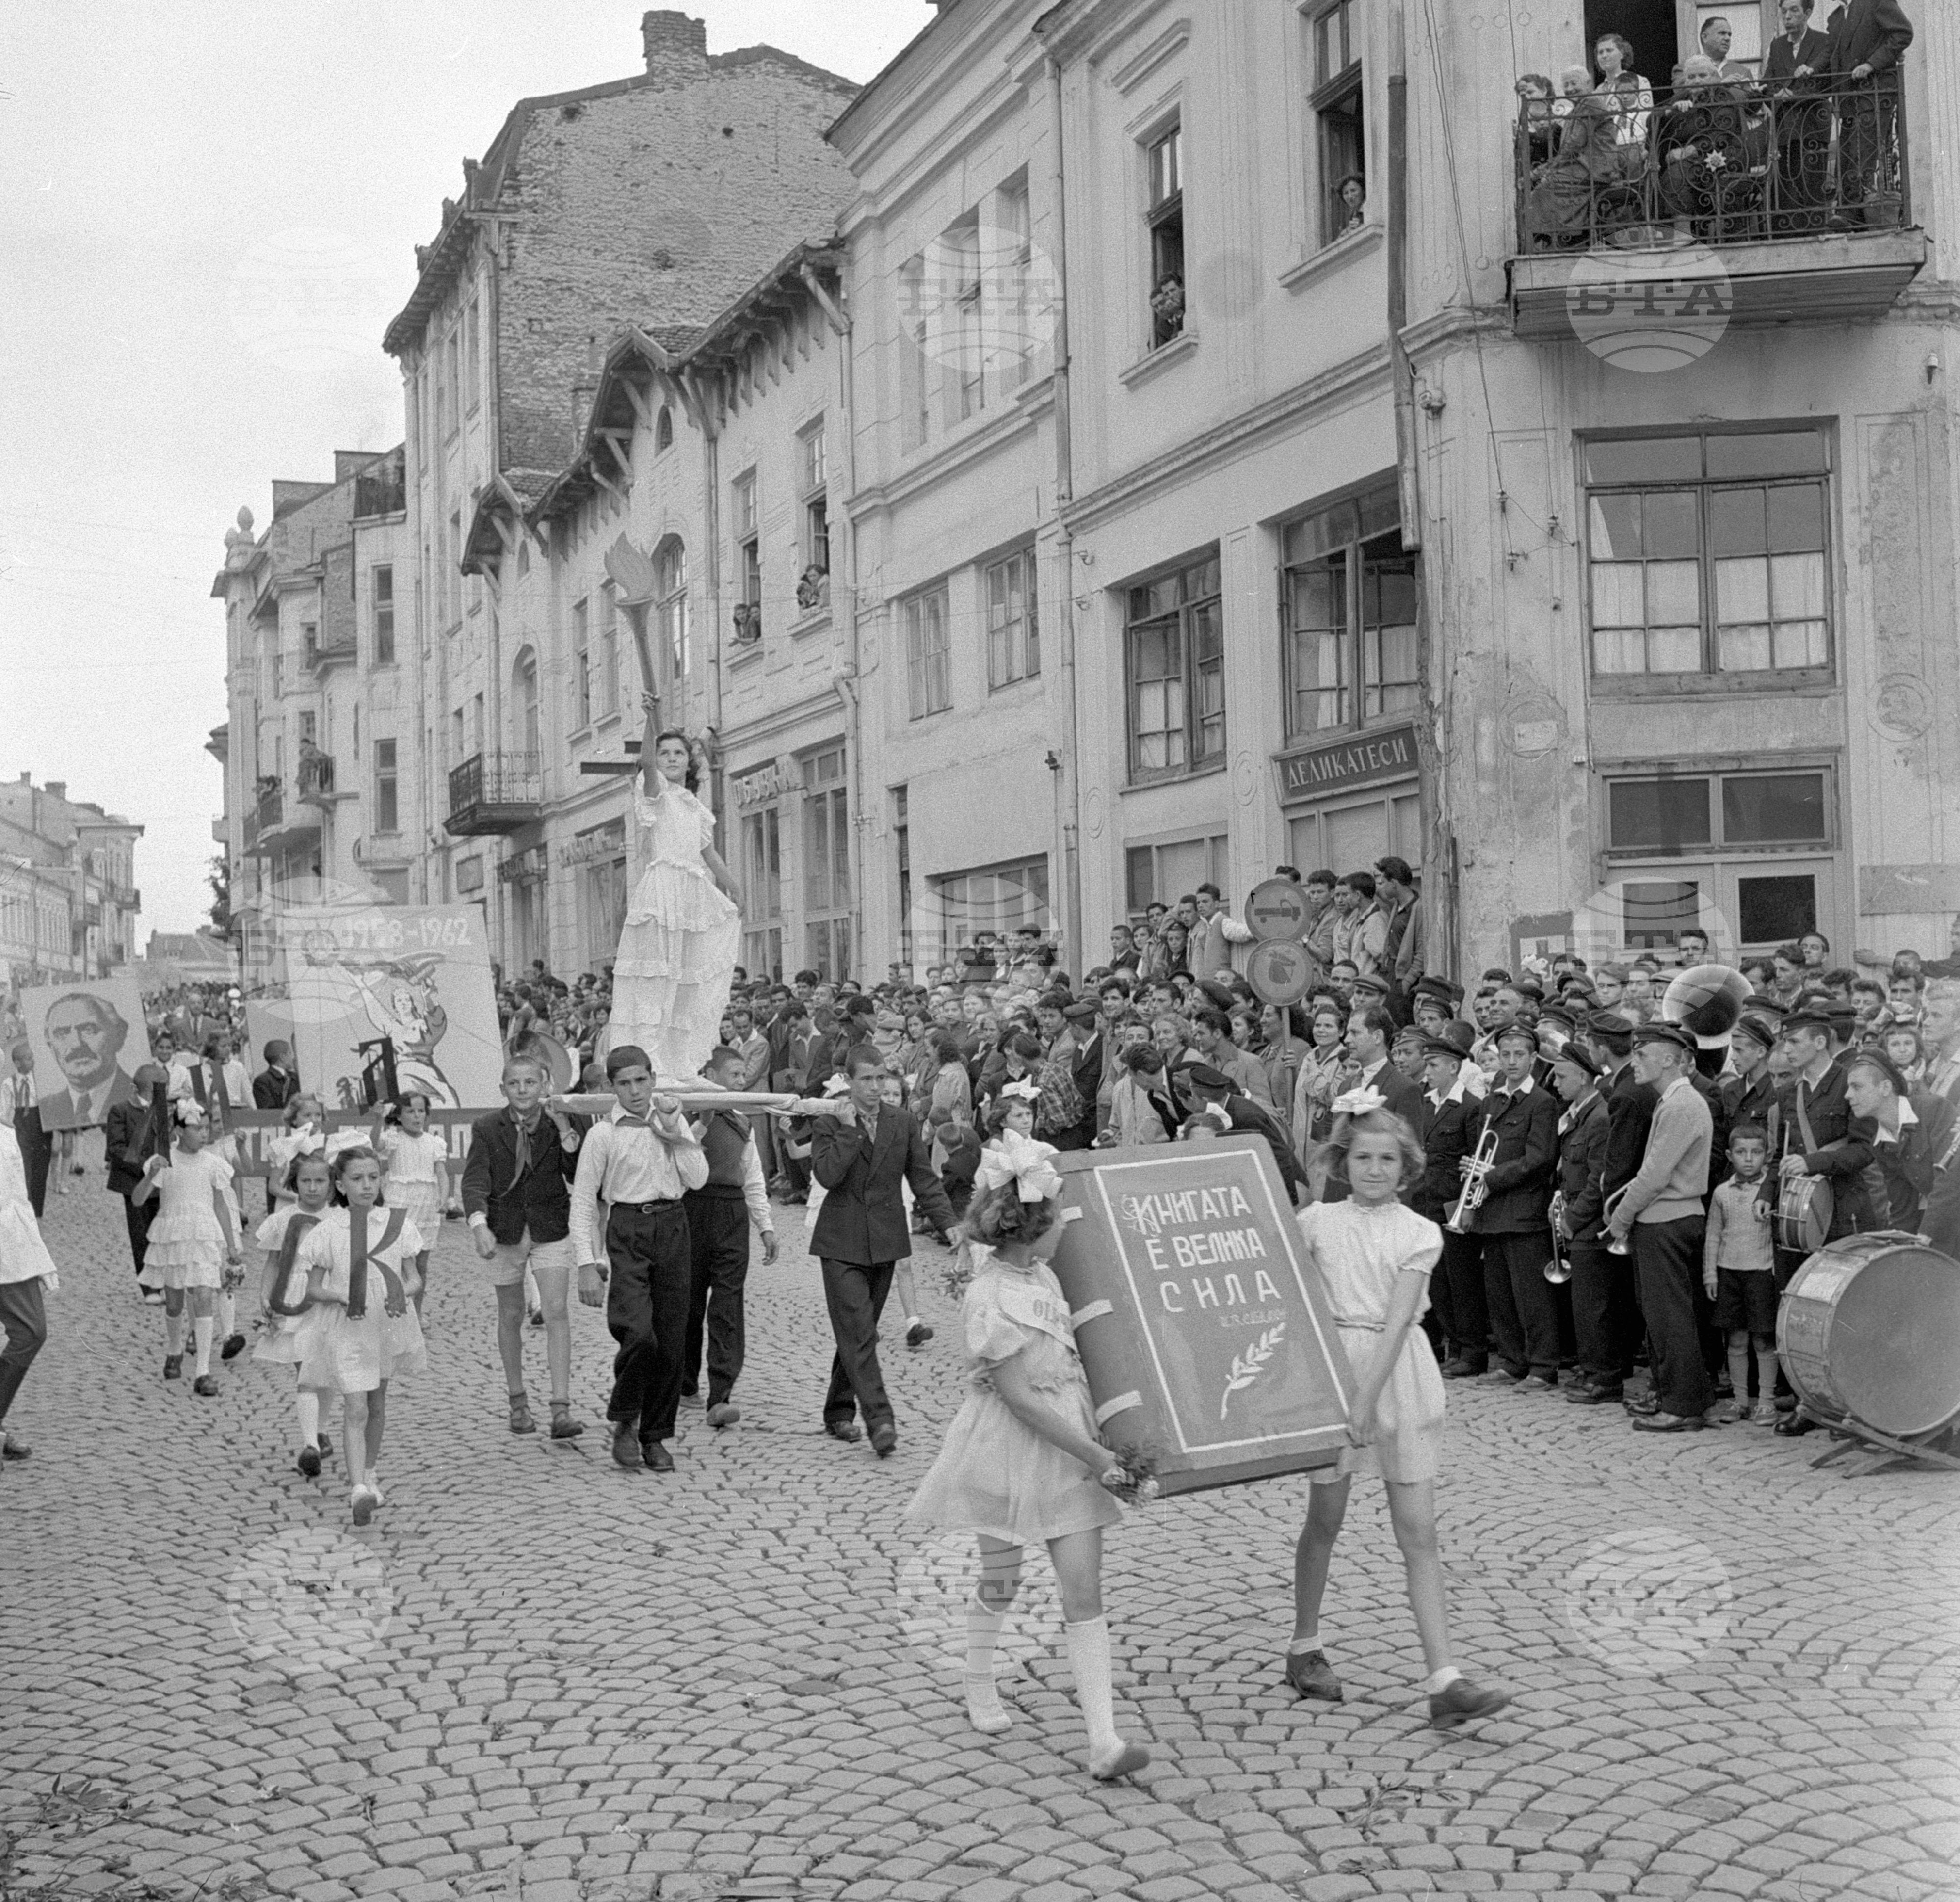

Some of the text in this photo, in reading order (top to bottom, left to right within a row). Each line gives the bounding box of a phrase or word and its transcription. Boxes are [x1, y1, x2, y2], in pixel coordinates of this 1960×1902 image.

[1288, 737, 1409, 790] ДЕЛИКАТЕСИ
[1123, 1186, 1252, 1235] КНИГАТА
[1145, 1227, 1268, 1270] Е ВЕЛИКА
